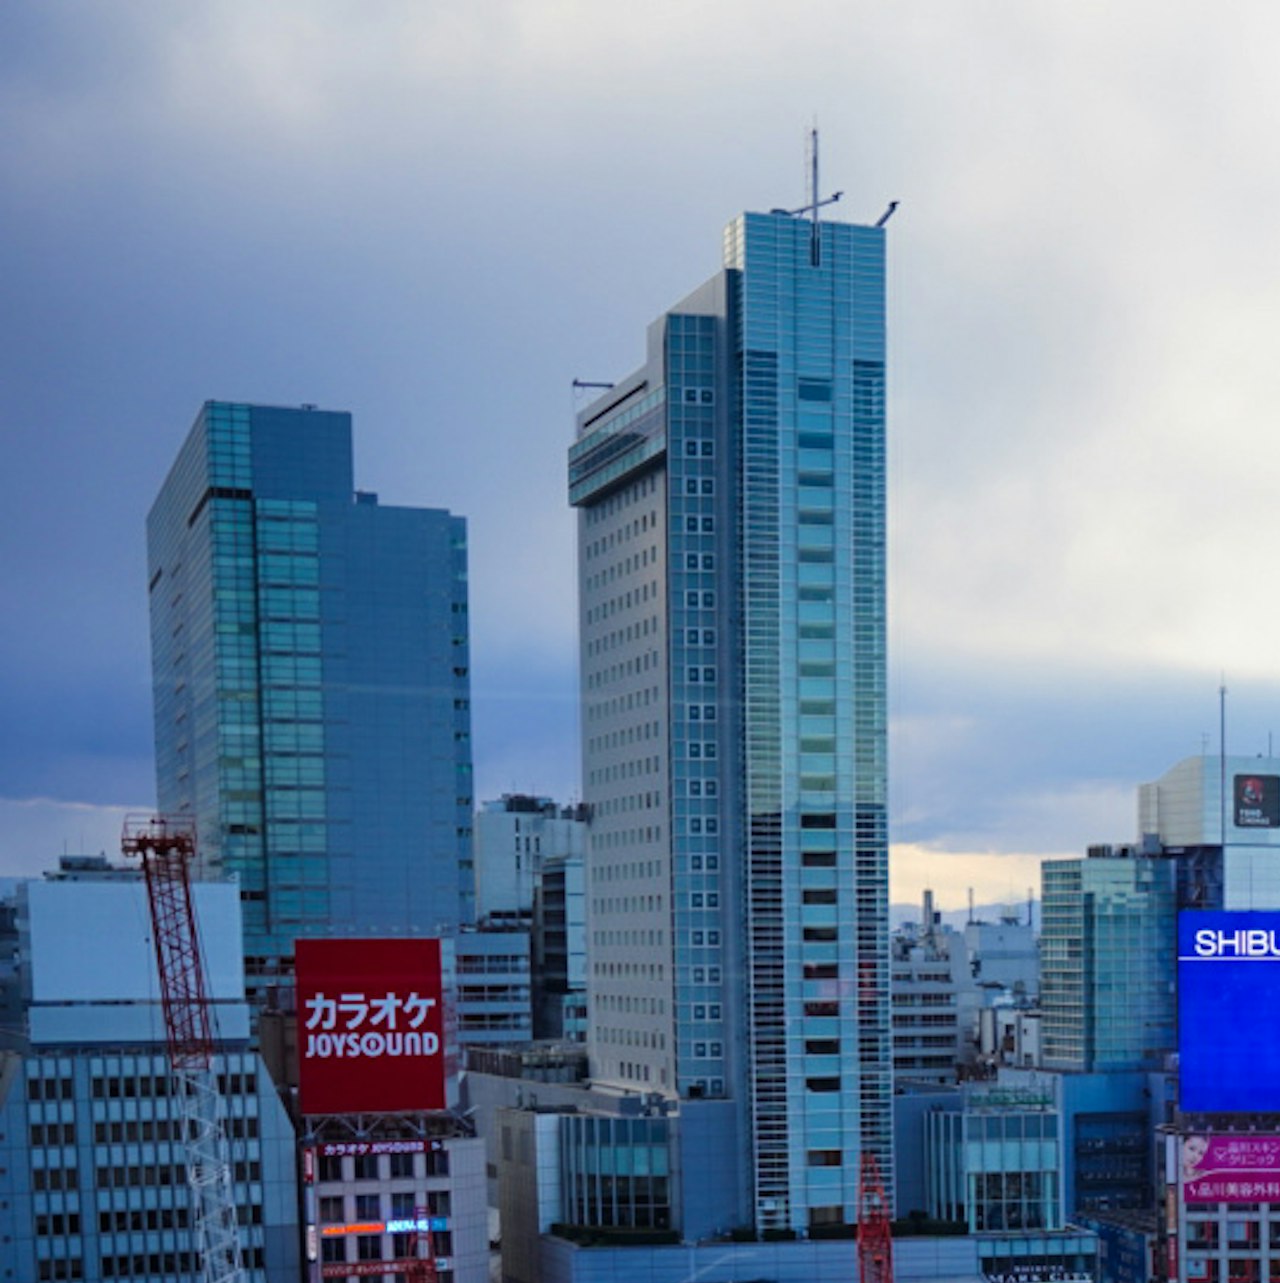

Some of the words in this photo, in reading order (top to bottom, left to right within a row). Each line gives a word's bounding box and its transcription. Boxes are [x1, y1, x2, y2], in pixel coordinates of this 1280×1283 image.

[305, 992, 436, 1030] カラオケ
[305, 1032, 439, 1058] JOYSOUND
